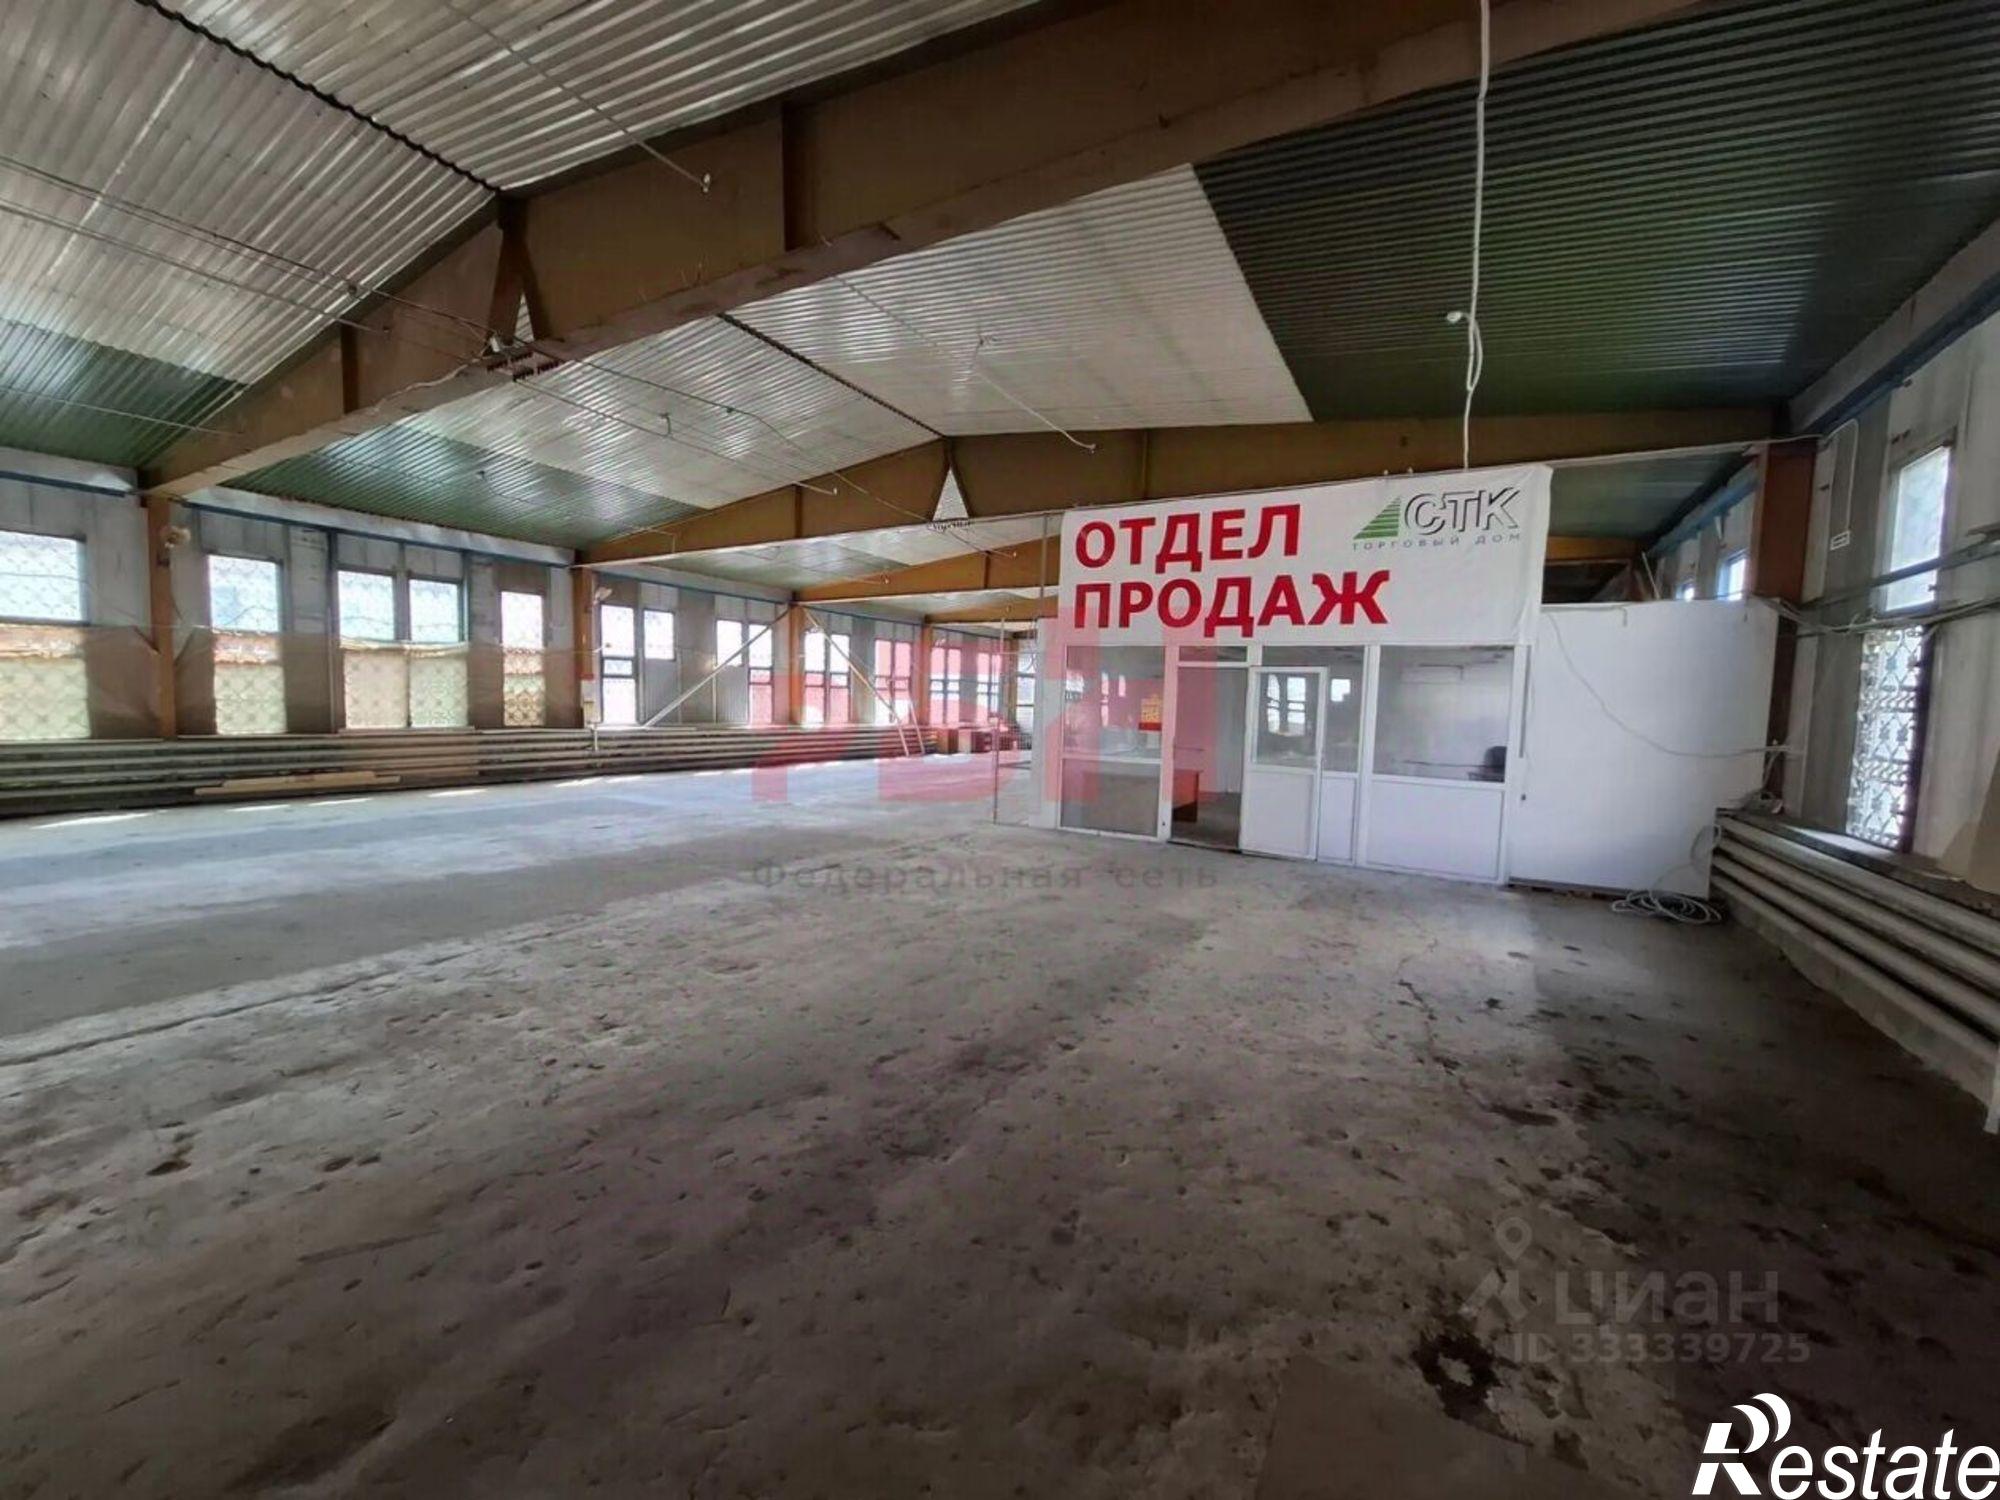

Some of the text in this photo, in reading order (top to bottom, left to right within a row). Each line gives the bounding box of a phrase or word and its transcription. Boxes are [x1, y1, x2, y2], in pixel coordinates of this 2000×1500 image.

[1075, 503, 1302, 574] ОТДЕЛ
[1404, 486, 1521, 536] СТК
[1352, 533, 1520, 551] ТОРГОВЫЙ ДОМ
[1074, 570, 1390, 638] ПРОДАЖ
